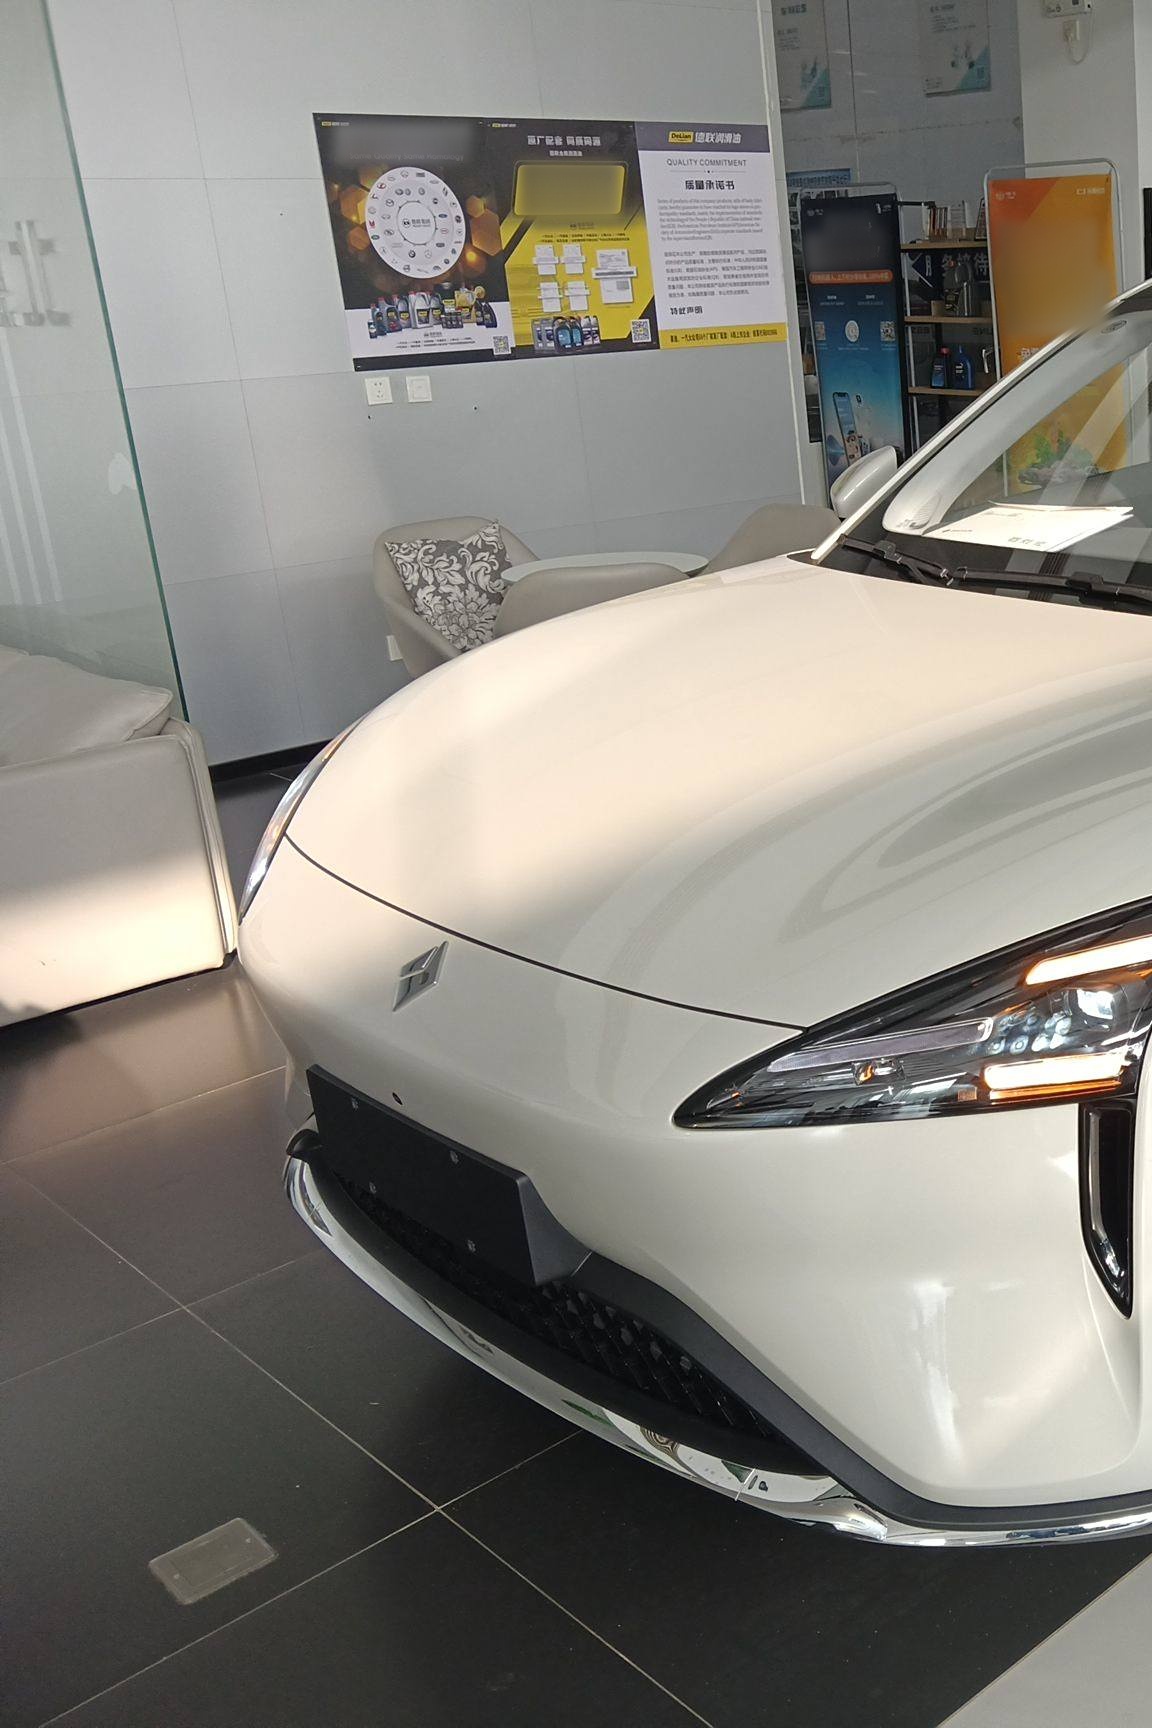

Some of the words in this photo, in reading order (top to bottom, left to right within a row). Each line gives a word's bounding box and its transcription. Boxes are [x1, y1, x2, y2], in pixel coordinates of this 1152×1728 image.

[666, 158, 698, 167] QUALITY
[700, 159, 747, 167] COMMITMENT
[685, 180, 735, 190] 质量承诺书
[670, 305, 703, 316] 特此声明
